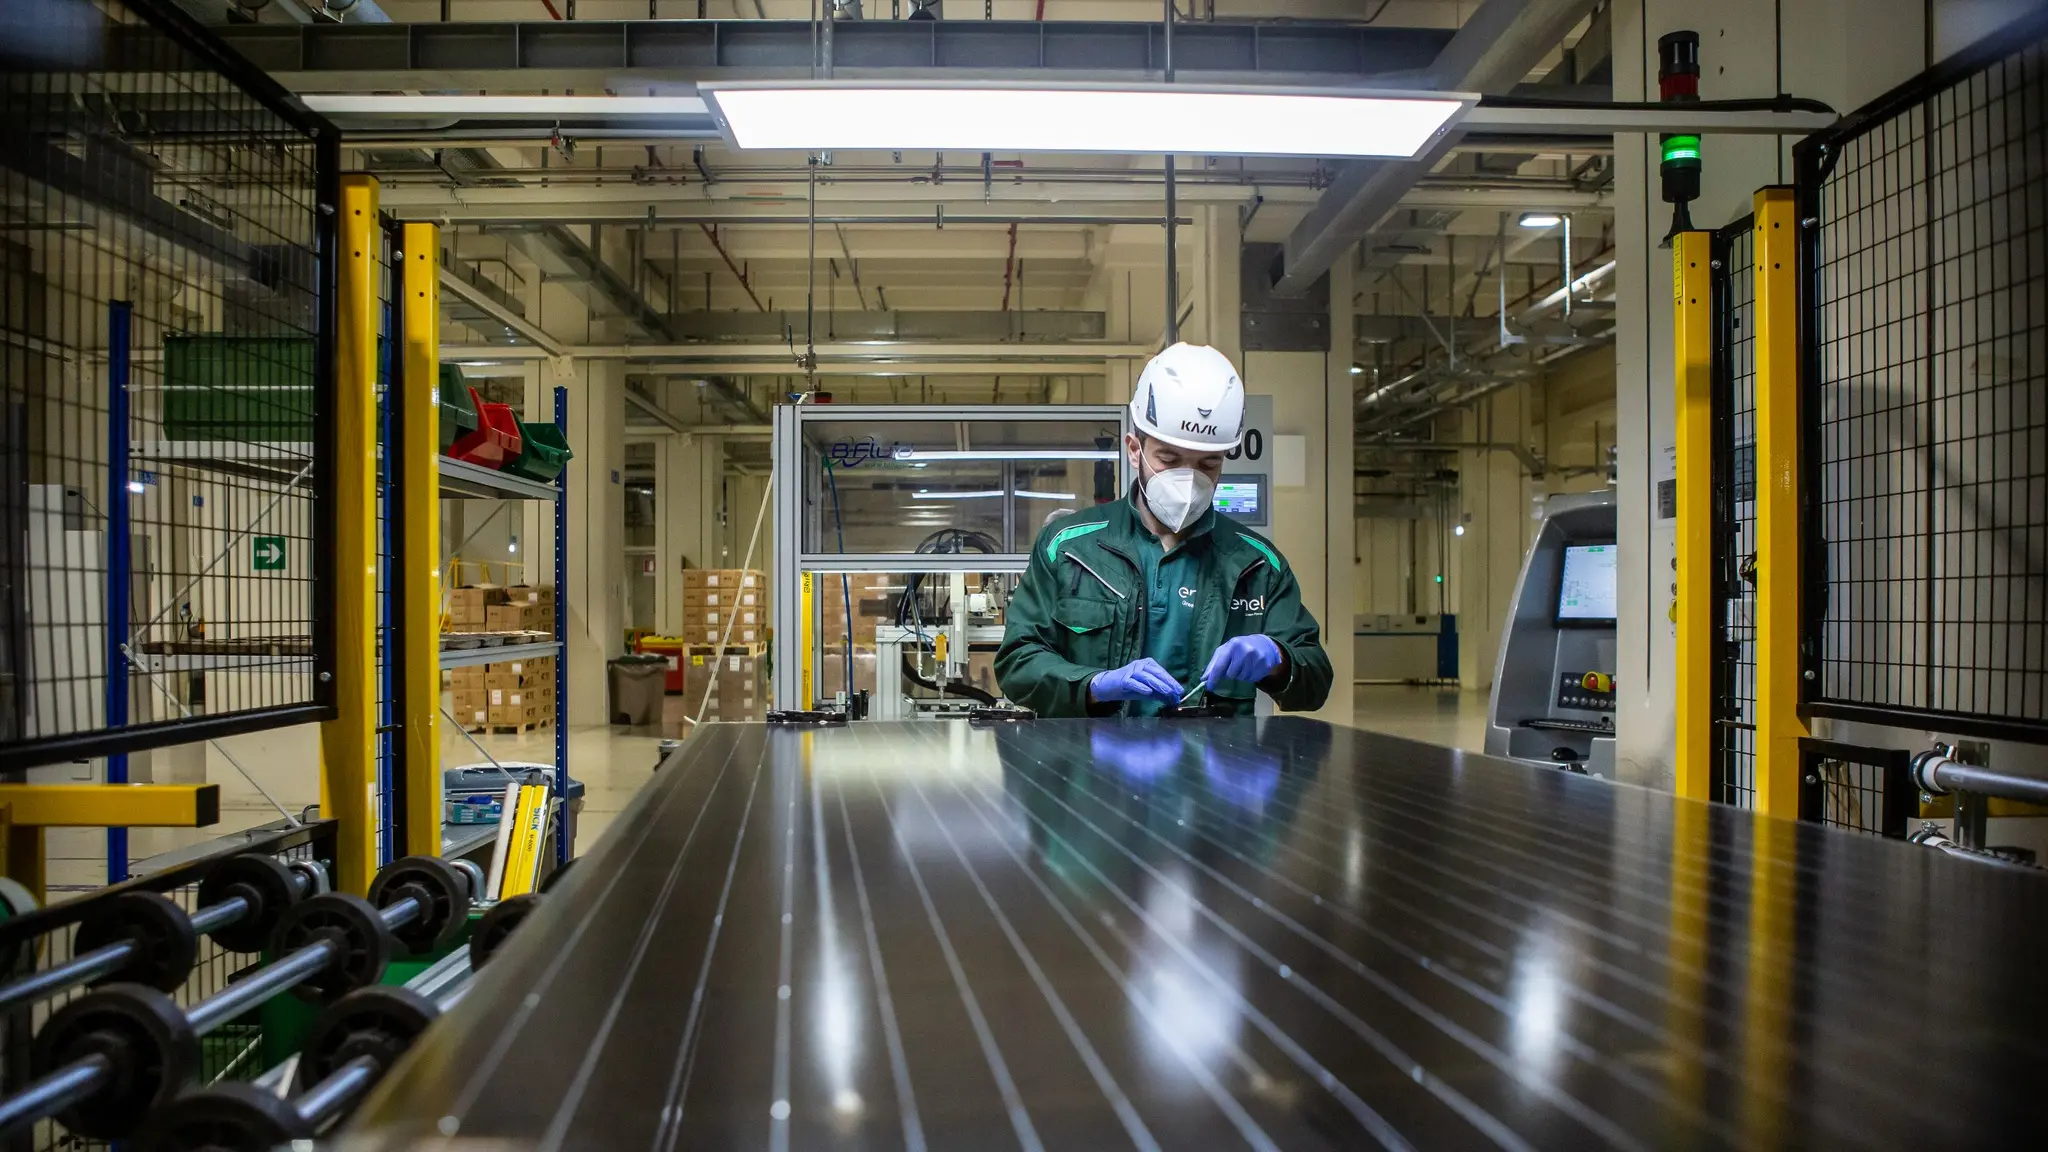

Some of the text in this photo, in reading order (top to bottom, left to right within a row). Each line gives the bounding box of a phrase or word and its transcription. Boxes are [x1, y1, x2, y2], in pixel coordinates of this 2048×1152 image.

[1181, 420, 1217, 436] KASK
[1230, 595, 1264, 610] enel
[531, 808, 541, 830] SICK
